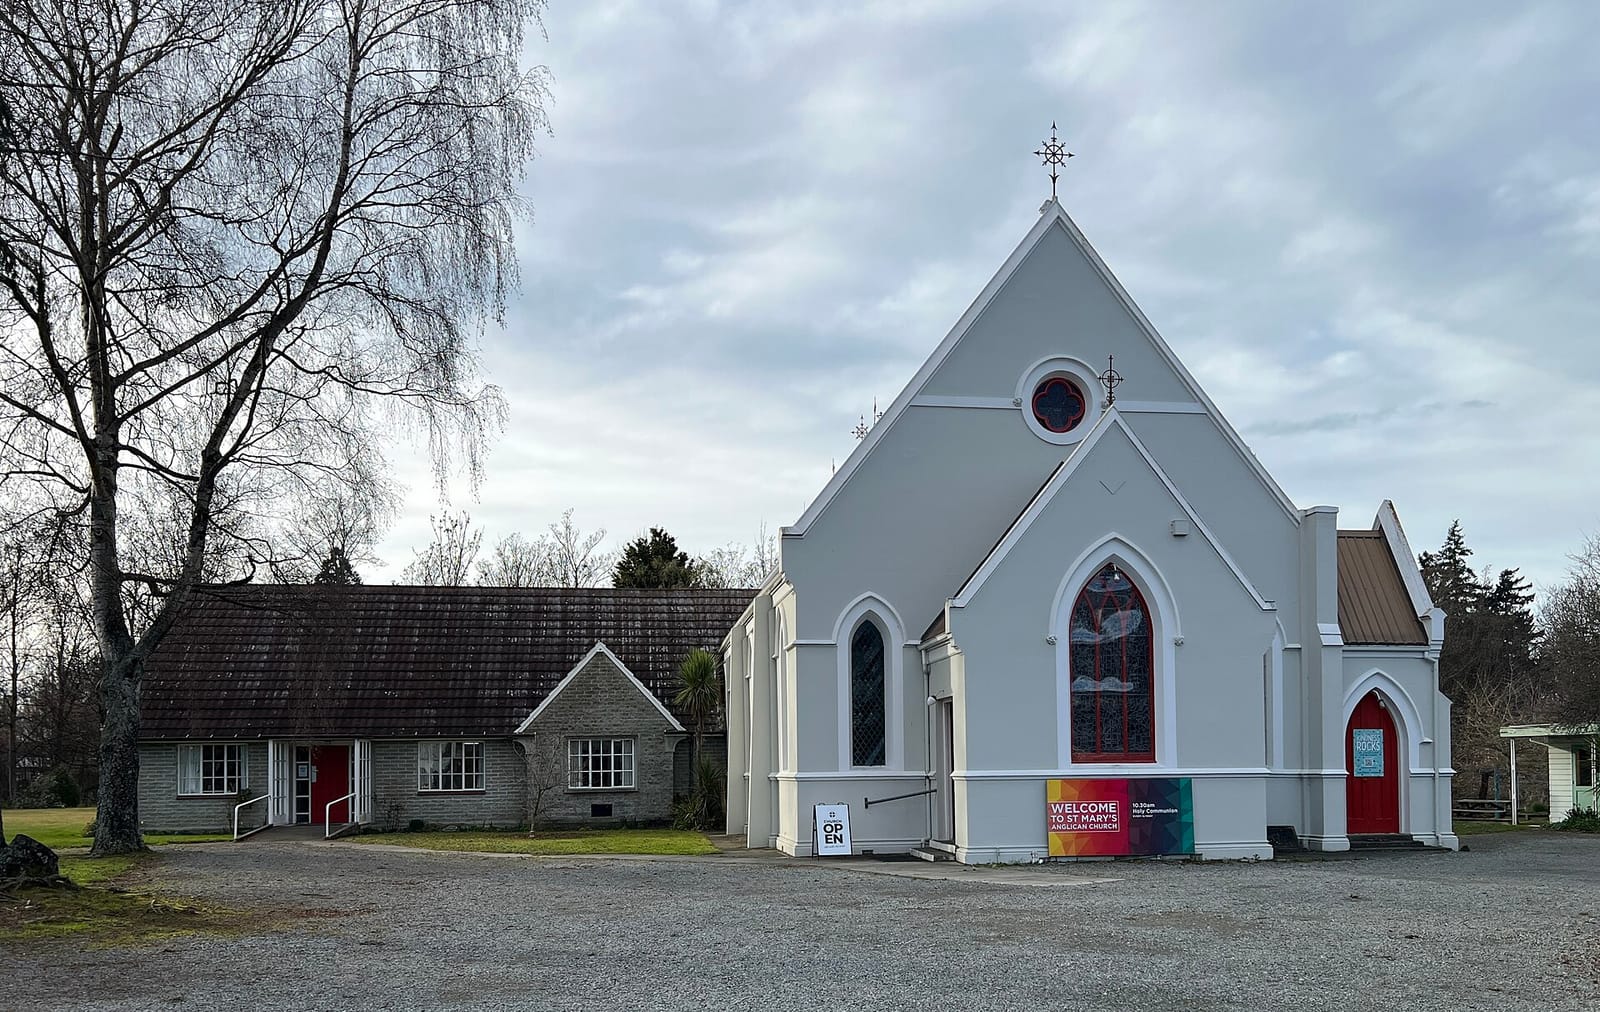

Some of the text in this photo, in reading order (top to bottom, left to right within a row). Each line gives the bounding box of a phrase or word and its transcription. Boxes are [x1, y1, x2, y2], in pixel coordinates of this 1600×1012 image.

[1356, 741, 1380, 751] ROCKS
[1051, 803, 1117, 813] WELCOME
[1051, 815, 1064, 823] TO
[1081, 814, 1117, 822] MARY'S
[823, 823, 843, 834] OP
[825, 834, 843, 844] EN
